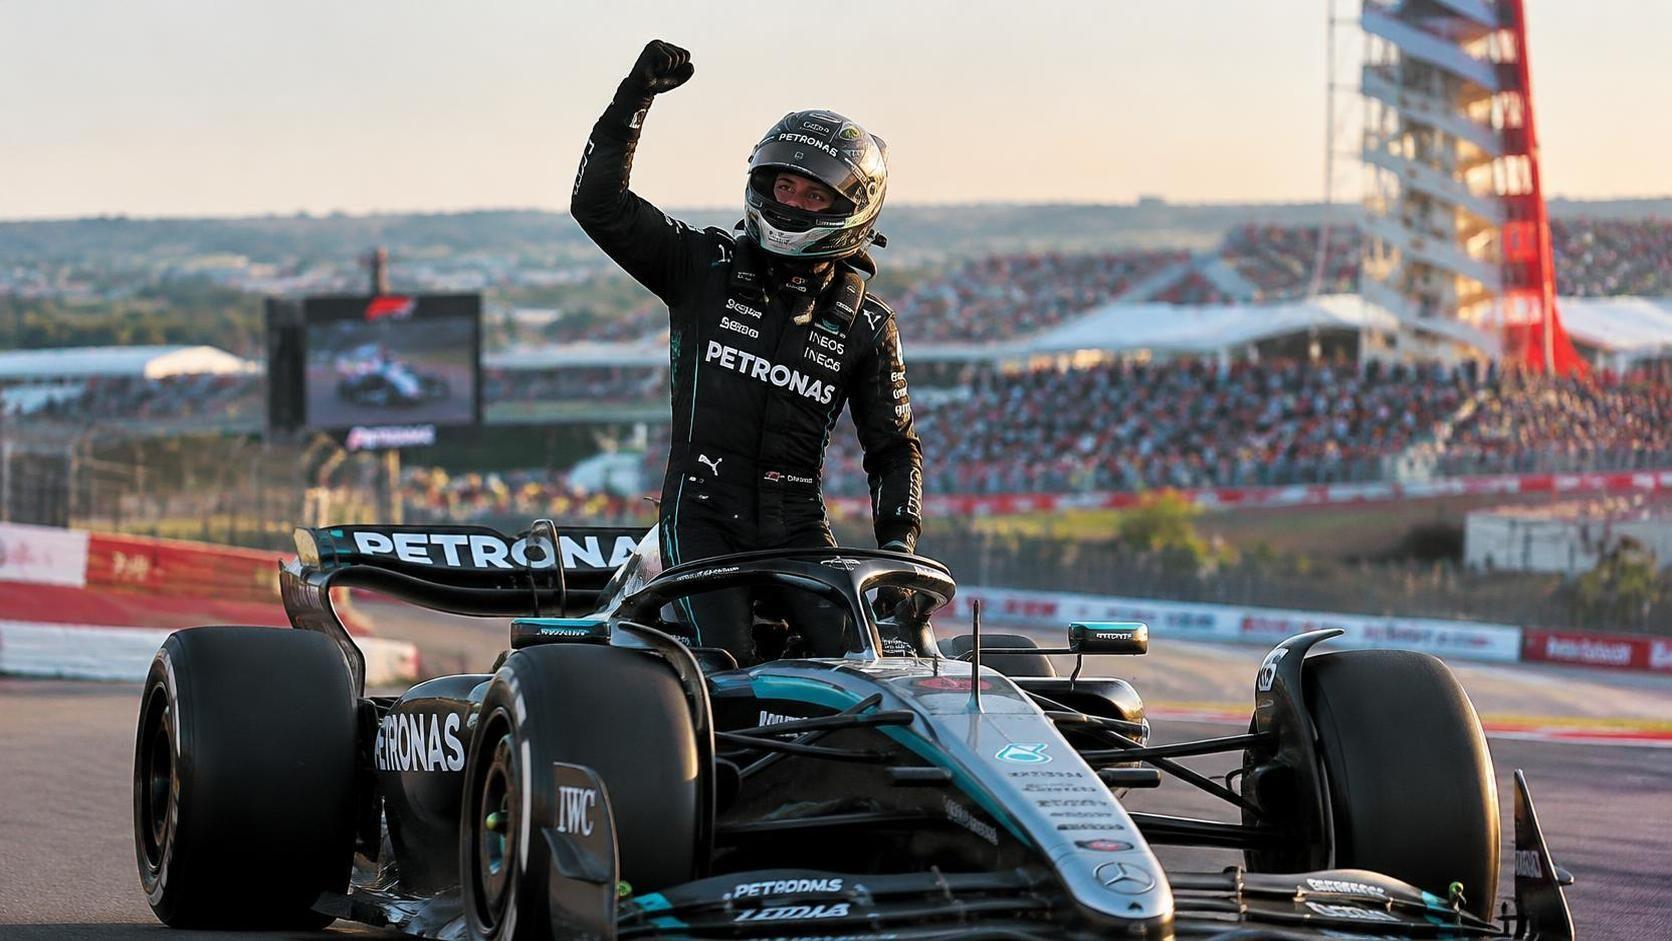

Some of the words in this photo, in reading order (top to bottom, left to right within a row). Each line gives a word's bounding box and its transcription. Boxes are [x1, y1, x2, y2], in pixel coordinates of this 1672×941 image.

[705, 340, 836, 404] PETRONAS
[353, 532, 637, 568] PETRONA
[557, 786, 596, 836] IWC
